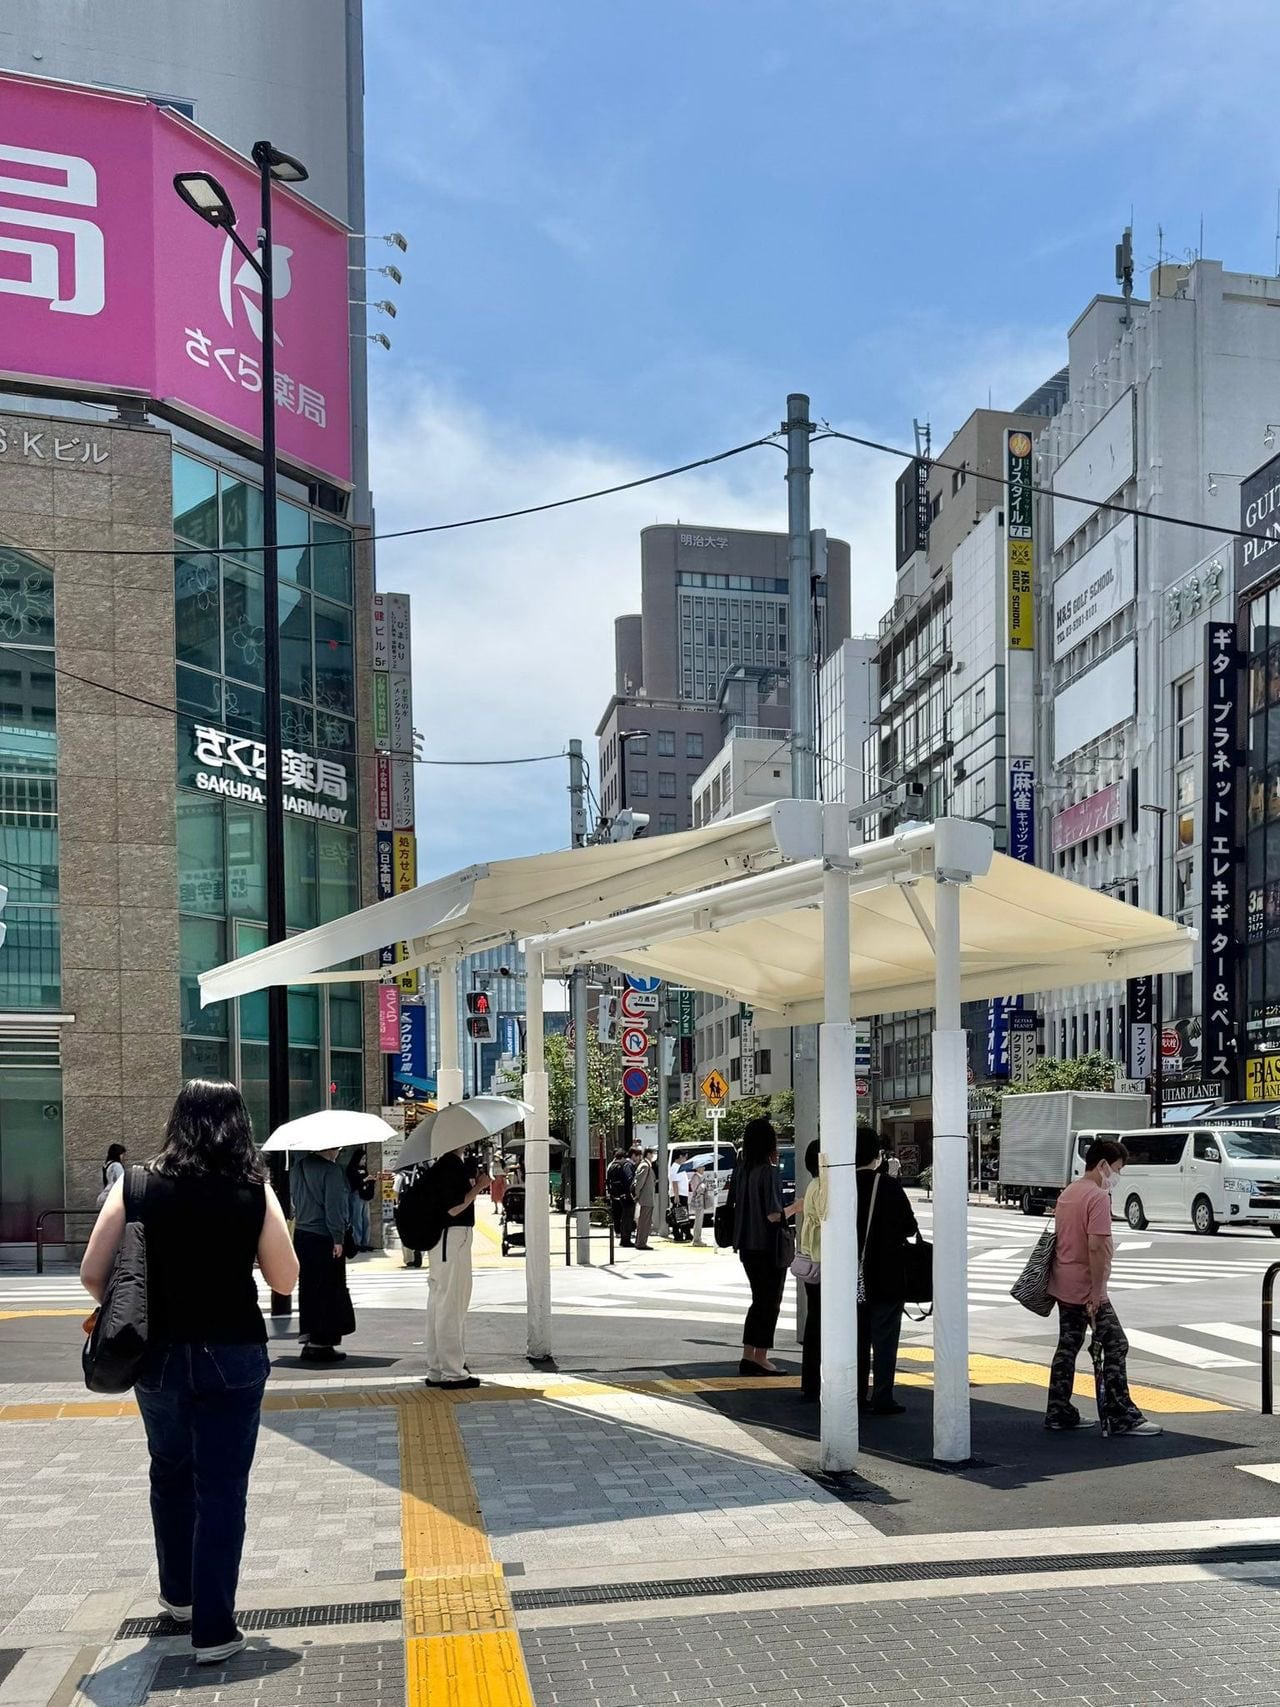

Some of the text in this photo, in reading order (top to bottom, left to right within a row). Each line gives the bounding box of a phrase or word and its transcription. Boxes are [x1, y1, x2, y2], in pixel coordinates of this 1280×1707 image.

[185, 327, 326, 428] さくら薬局
[680, 534, 729, 549] 明治大学
[1012, 525, 1028, 536] 7F
[1012, 570, 1020, 630] GOLF SCHOOL
[1089, 567, 1114, 601] SCHOOL
[194, 724, 348, 802] さくら薬局
[1013, 760, 1032, 770] 4F
[1013, 773, 1032, 811] 麻雀
[1211, 629, 1233, 1075] ギタープラネット エレキギター&ベース
[386, 989, 398, 1023] さくら
[1014, 1034, 1022, 1082] クラシック
[1136, 1027, 1147, 1075] フェンダー
[1161, 1083, 1221, 1102] UITAR PLANET
